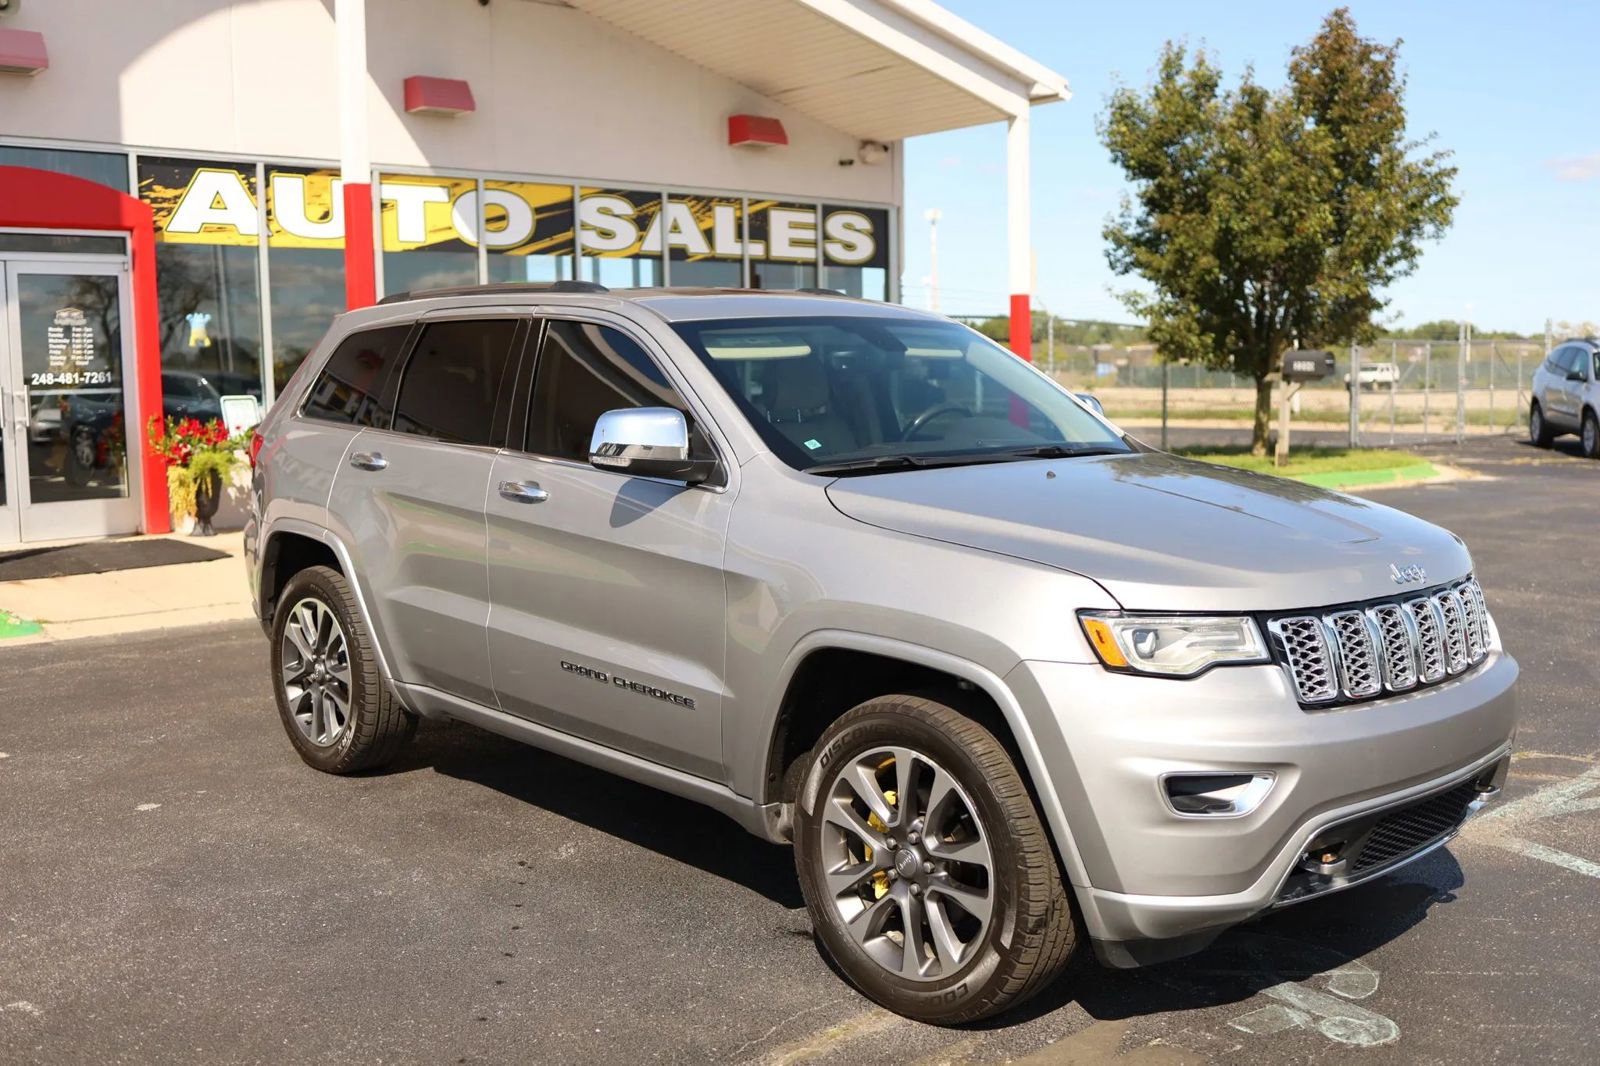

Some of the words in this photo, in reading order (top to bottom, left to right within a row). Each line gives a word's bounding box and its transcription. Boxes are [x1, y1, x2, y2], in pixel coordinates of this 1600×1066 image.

[165, 168, 535, 252] AUTO
[574, 194, 876, 264] SALES
[31, 371, 112, 385] 248-481-7261
[1389, 563, 1425, 584] Jeep
[560, 660, 609, 682] GRAND
[613, 676, 696, 708] CHEROKEE
